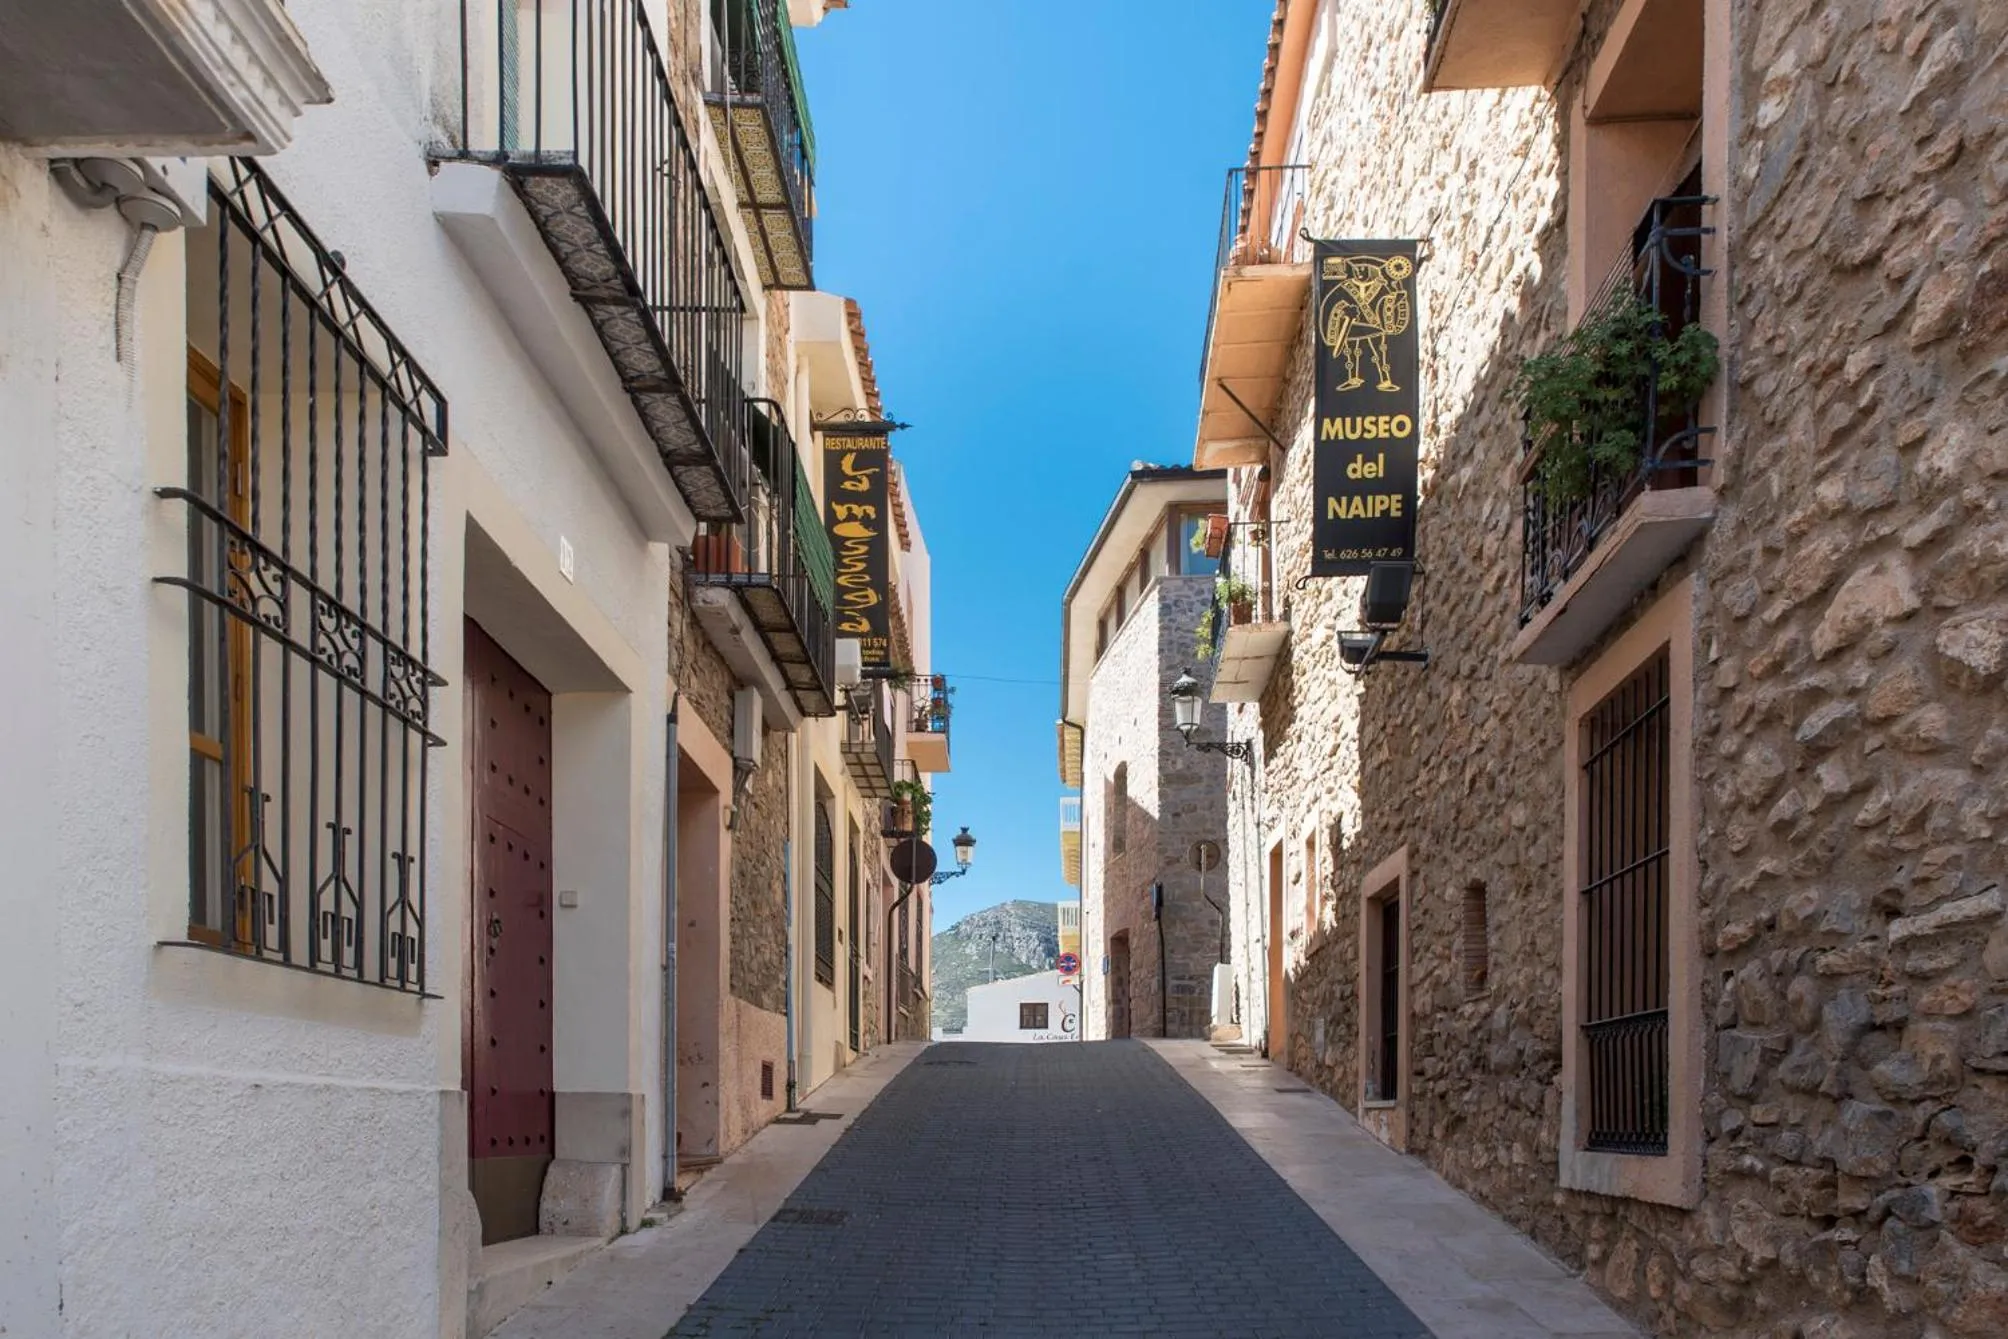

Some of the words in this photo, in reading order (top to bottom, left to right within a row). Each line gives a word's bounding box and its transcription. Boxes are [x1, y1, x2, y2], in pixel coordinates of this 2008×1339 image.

[1320, 414, 1412, 441] MUSEO
[825, 437, 887, 450] RESTAURANTE
[1346, 452, 1385, 479] del
[1327, 494, 1403, 520] NAIPE
[1340, 547, 1359, 560] 626
[1360, 547, 1373, 559] 56
[1375, 546, 1389, 558] 47
[1390, 546, 1404, 558] 49
